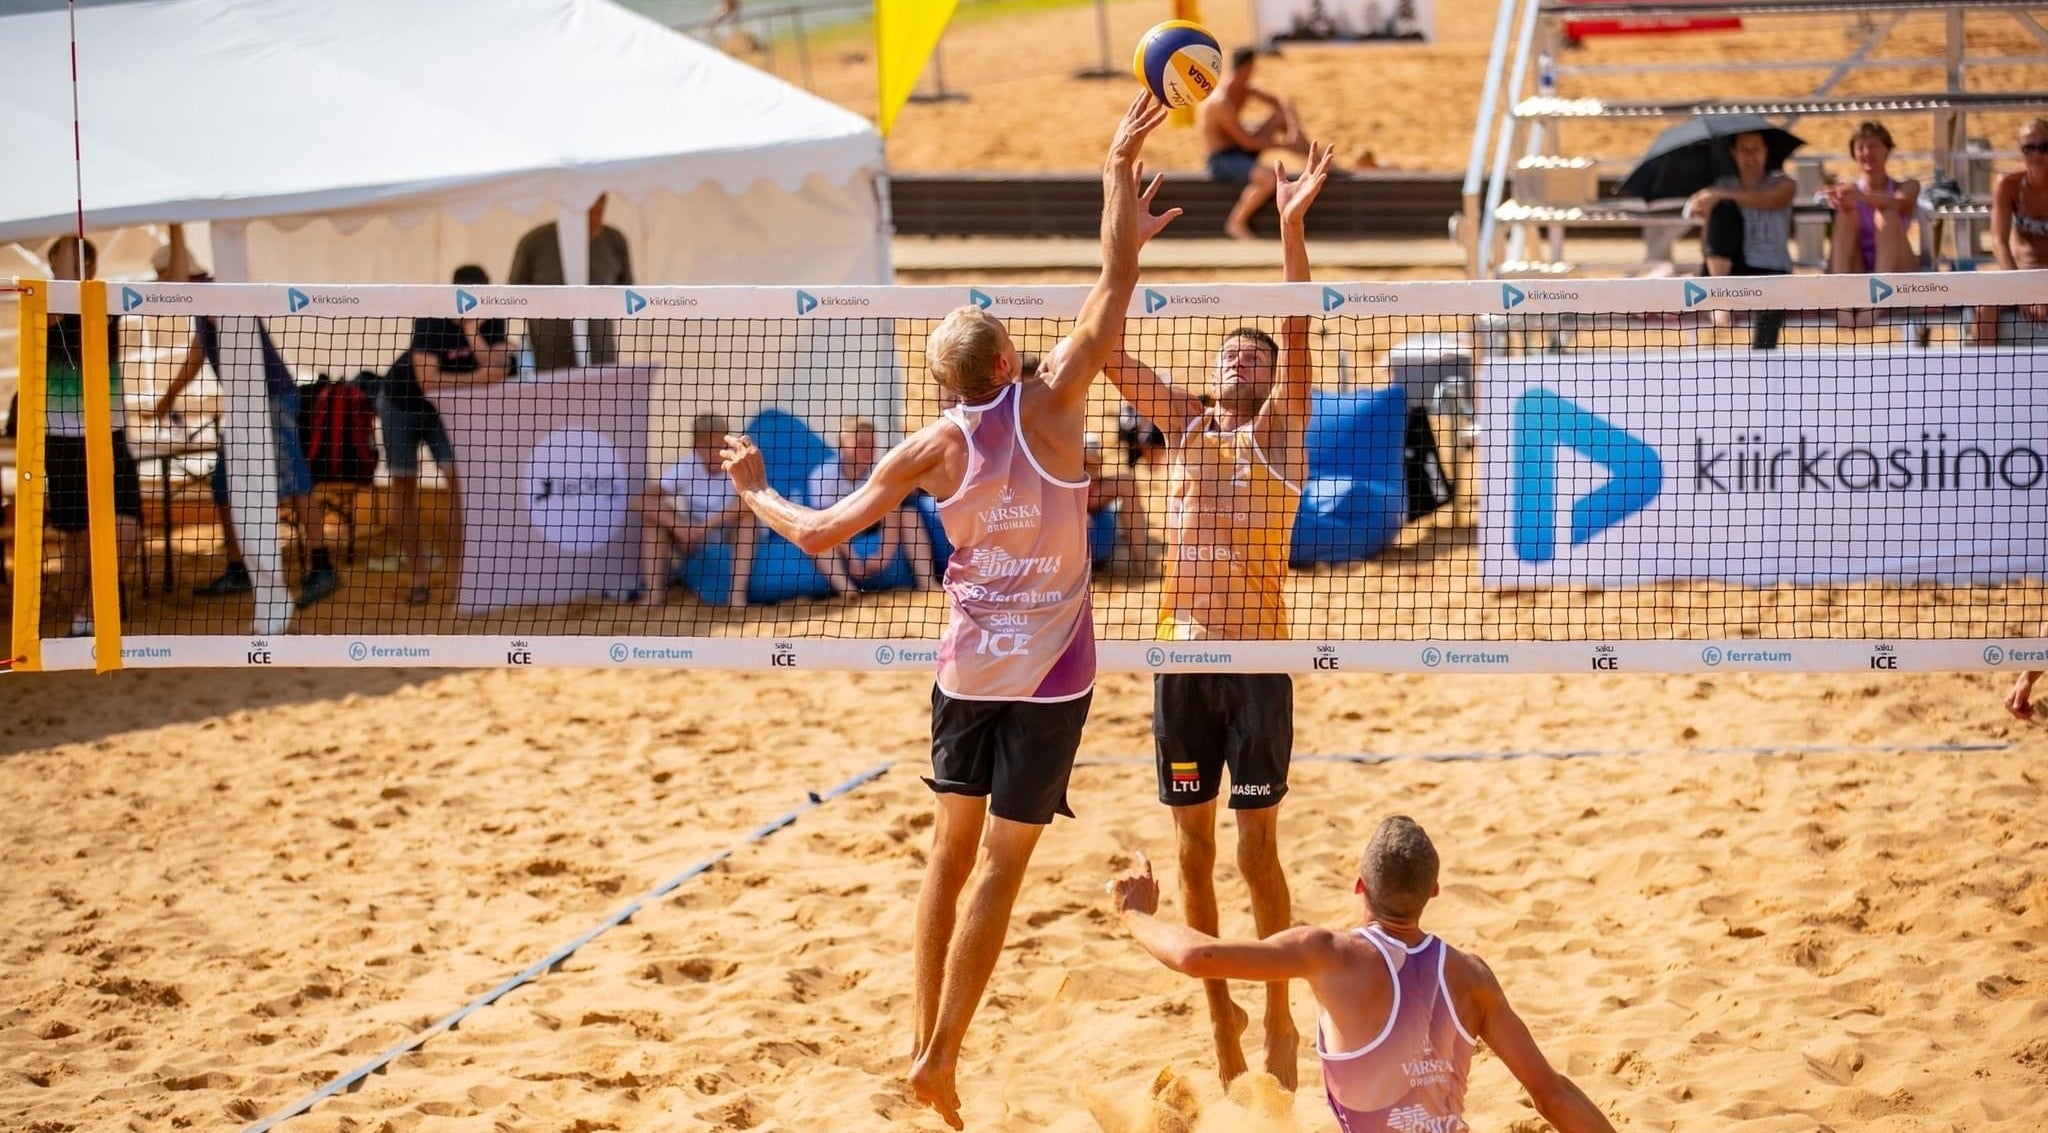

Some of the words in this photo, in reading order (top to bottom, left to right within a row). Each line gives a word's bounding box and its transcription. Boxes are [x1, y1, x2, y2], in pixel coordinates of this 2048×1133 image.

[1710, 287, 1763, 299] kiirkasiino
[1896, 283, 1949, 295] kiirkasiino
[146, 294, 193, 303] kiirkasiino
[312, 294, 360, 305] kiirkasiino
[480, 296, 528, 306] kiirkasiino
[649, 296, 698, 307] kiirkasiino
[820, 296, 870, 307] kiirkasiino
[995, 296, 1044, 306] kiirkasiino
[1170, 294, 1220, 305] kiirkasiino
[1348, 293, 1399, 304] kiirkasiino
[1528, 290, 1579, 302] kiirkasiino
[1696, 432, 2044, 491] kiirkasiino
[978, 504, 1041, 523] VÄRSKA
[987, 520, 1036, 533] ORIGINAAL
[987, 550, 1062, 577] barrus
[989, 589, 1062, 603] ferratum
[990, 612, 1028, 626] saku
[251, 639, 268, 647] saku
[511, 639, 528, 647] saku
[775, 642, 793, 650] saku
[976, 629, 1031, 657] ICE
[120, 646, 172, 657] erratum
[371, 646, 430, 658] ferratum
[632, 646, 693, 660] ferratum
[899, 649, 938, 661] ferrat
[1169, 651, 1232, 664] ferratum
[1446, 651, 1509, 664] ferratum
[1727, 649, 1792, 662] ferratum
[247, 652, 272, 664] ICE
[507, 652, 532, 664] ICE
[771, 654, 796, 666] ICE
[1313, 657, 1338, 669] ICE
[1592, 657, 1618, 669] ICE
[1871, 656, 1897, 669] ICE
[1172, 781, 1200, 792] LTU
